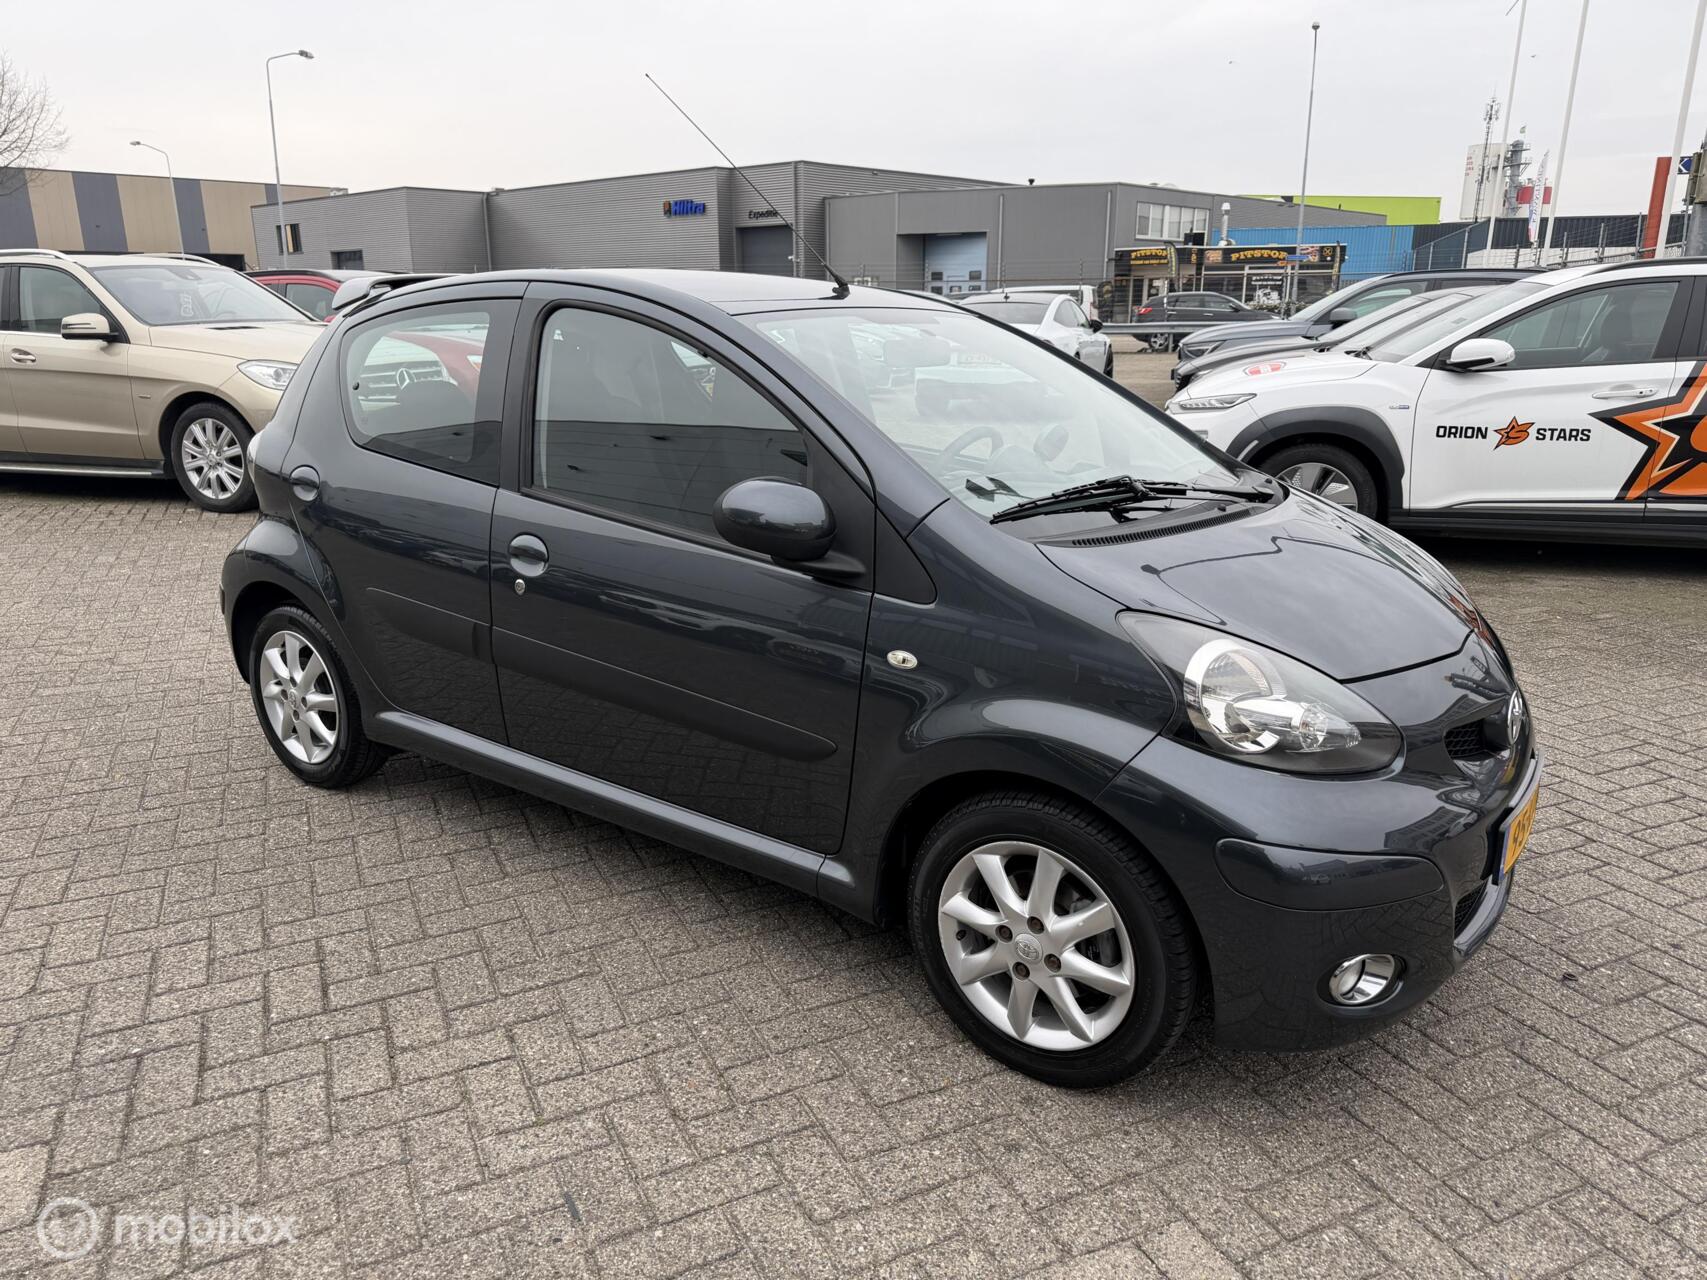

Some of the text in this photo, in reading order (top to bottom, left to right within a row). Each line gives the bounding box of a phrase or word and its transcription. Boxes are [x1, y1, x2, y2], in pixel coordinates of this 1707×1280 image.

[1231, 249, 1288, 261] PITSTOP
[1435, 425, 1488, 440] ORION
[1535, 427, 1592, 442] STARS
